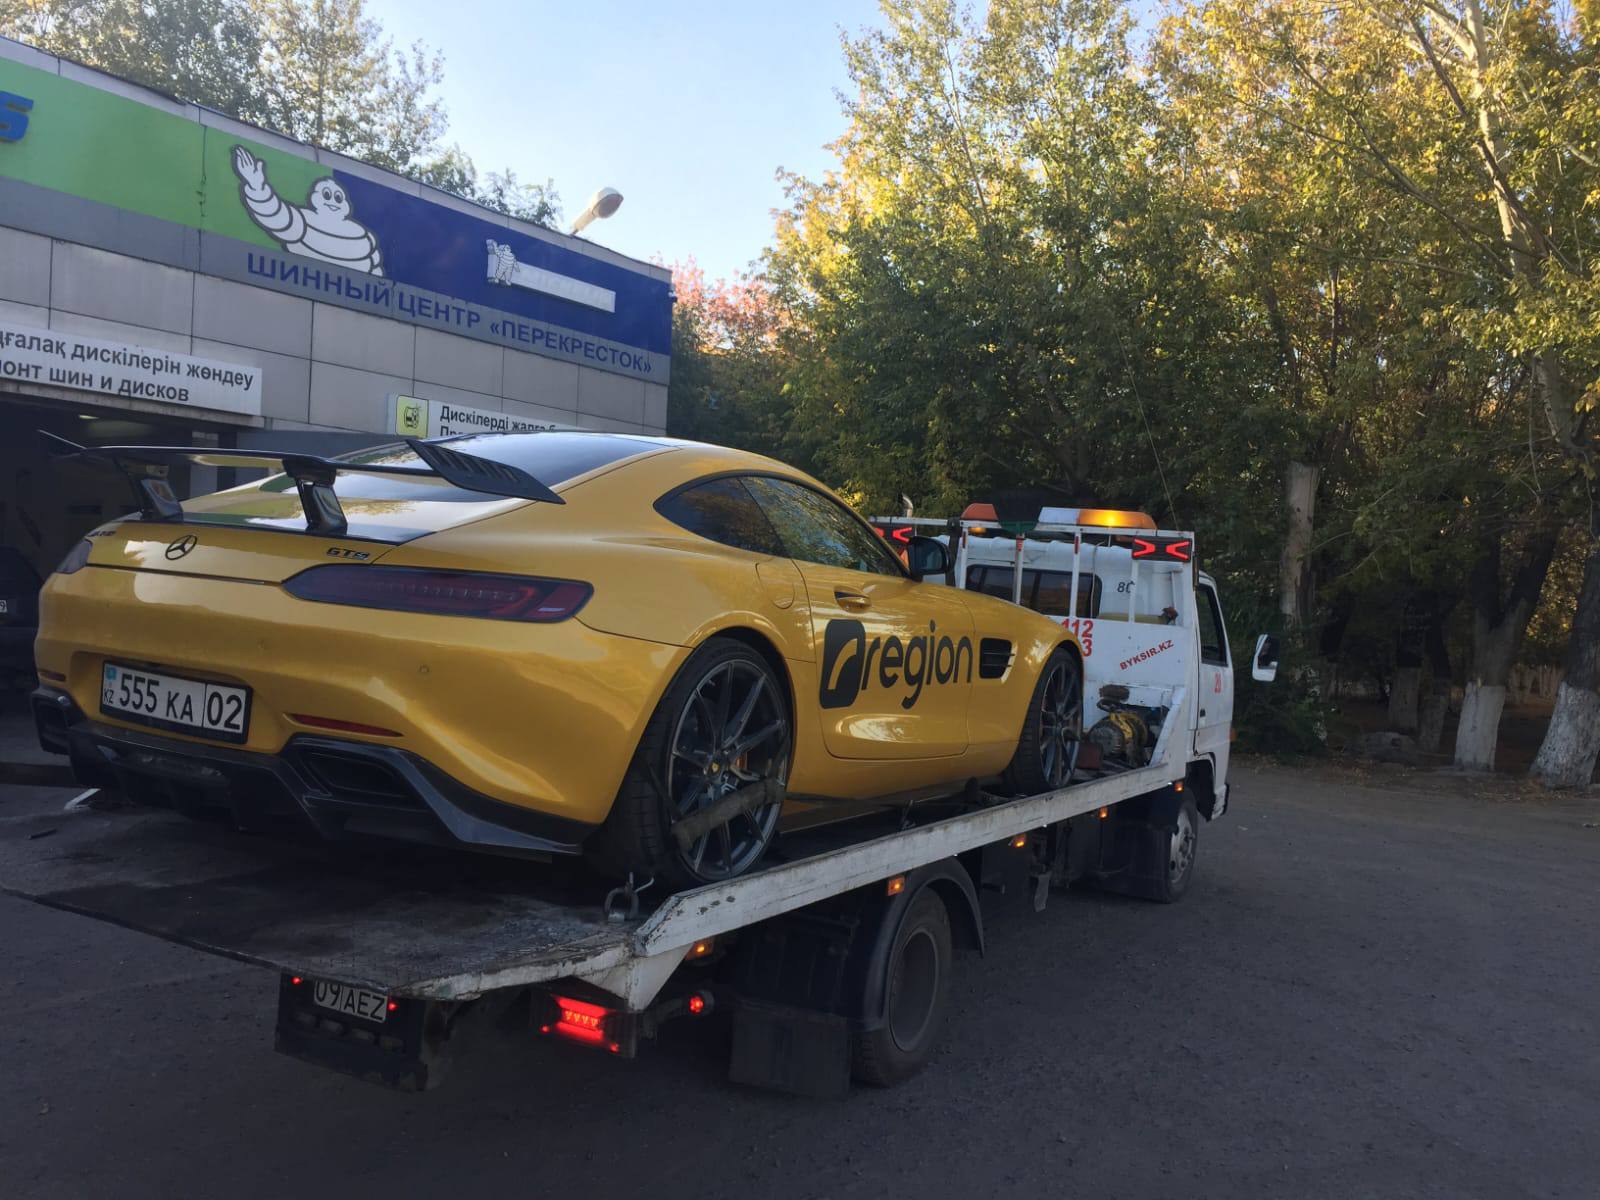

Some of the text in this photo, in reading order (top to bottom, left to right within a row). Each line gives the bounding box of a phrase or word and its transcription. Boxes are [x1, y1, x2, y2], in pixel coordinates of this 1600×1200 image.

[247, 252, 652, 373] ШИННЫЙ ЦЕНТР «ПЕРЕКРЕСТОК»
[0, 359, 189, 402] онт шин и дисков
[71, 344, 181, 375] дискілерін
[186, 362, 254, 390] жөндеу
[440, 405, 509, 430] Дискілерді
[861, 619, 974, 710] region
[119, 673, 243, 731] 555 KA 02
